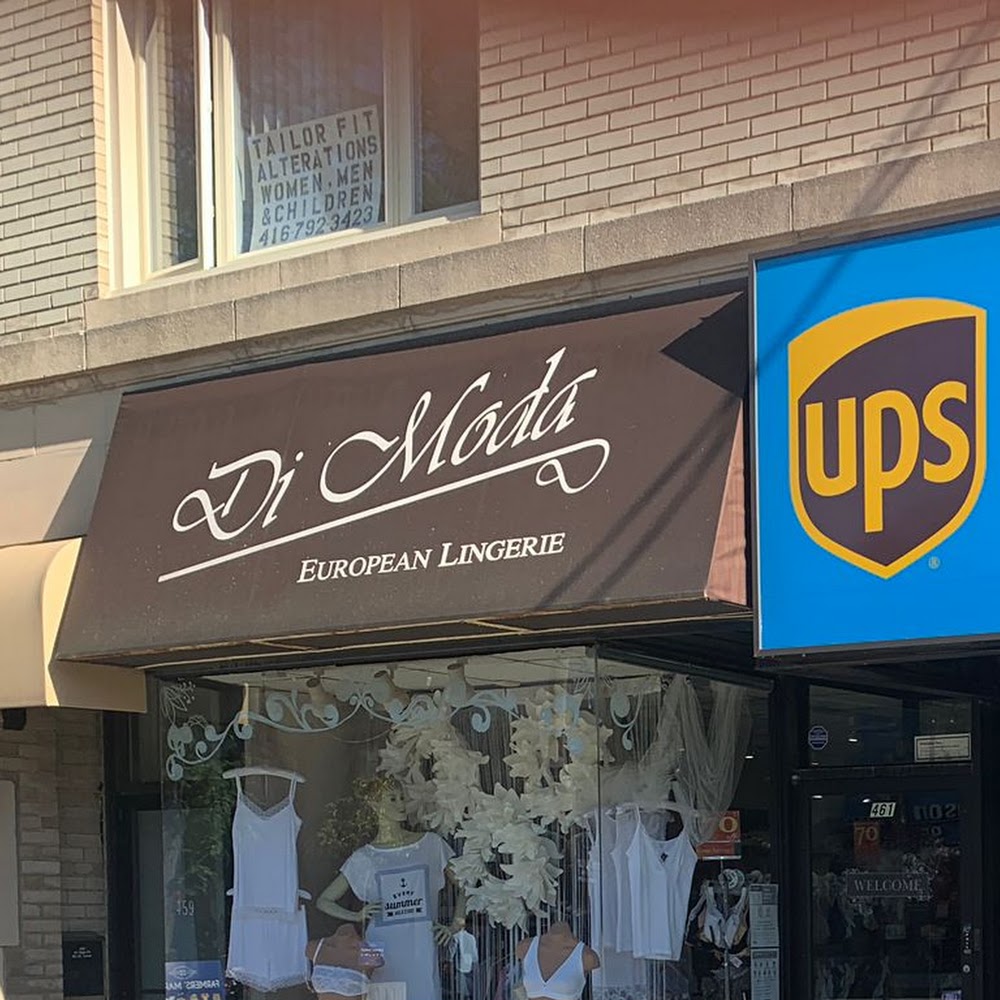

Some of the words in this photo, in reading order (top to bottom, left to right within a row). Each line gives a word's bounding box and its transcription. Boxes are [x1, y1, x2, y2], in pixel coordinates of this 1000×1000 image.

[252, 123, 326, 159] TAILOR
[336, 111, 373, 138] FIT
[257, 135, 378, 183] ALTERATIONS
[337, 160, 373, 187] MEN
[172, 449, 303, 540] Di
[319, 346, 598, 504] Moda
[805, 380, 970, 533] ups
[872, 803, 894, 817] 461
[854, 878, 922, 893] WELCOME
